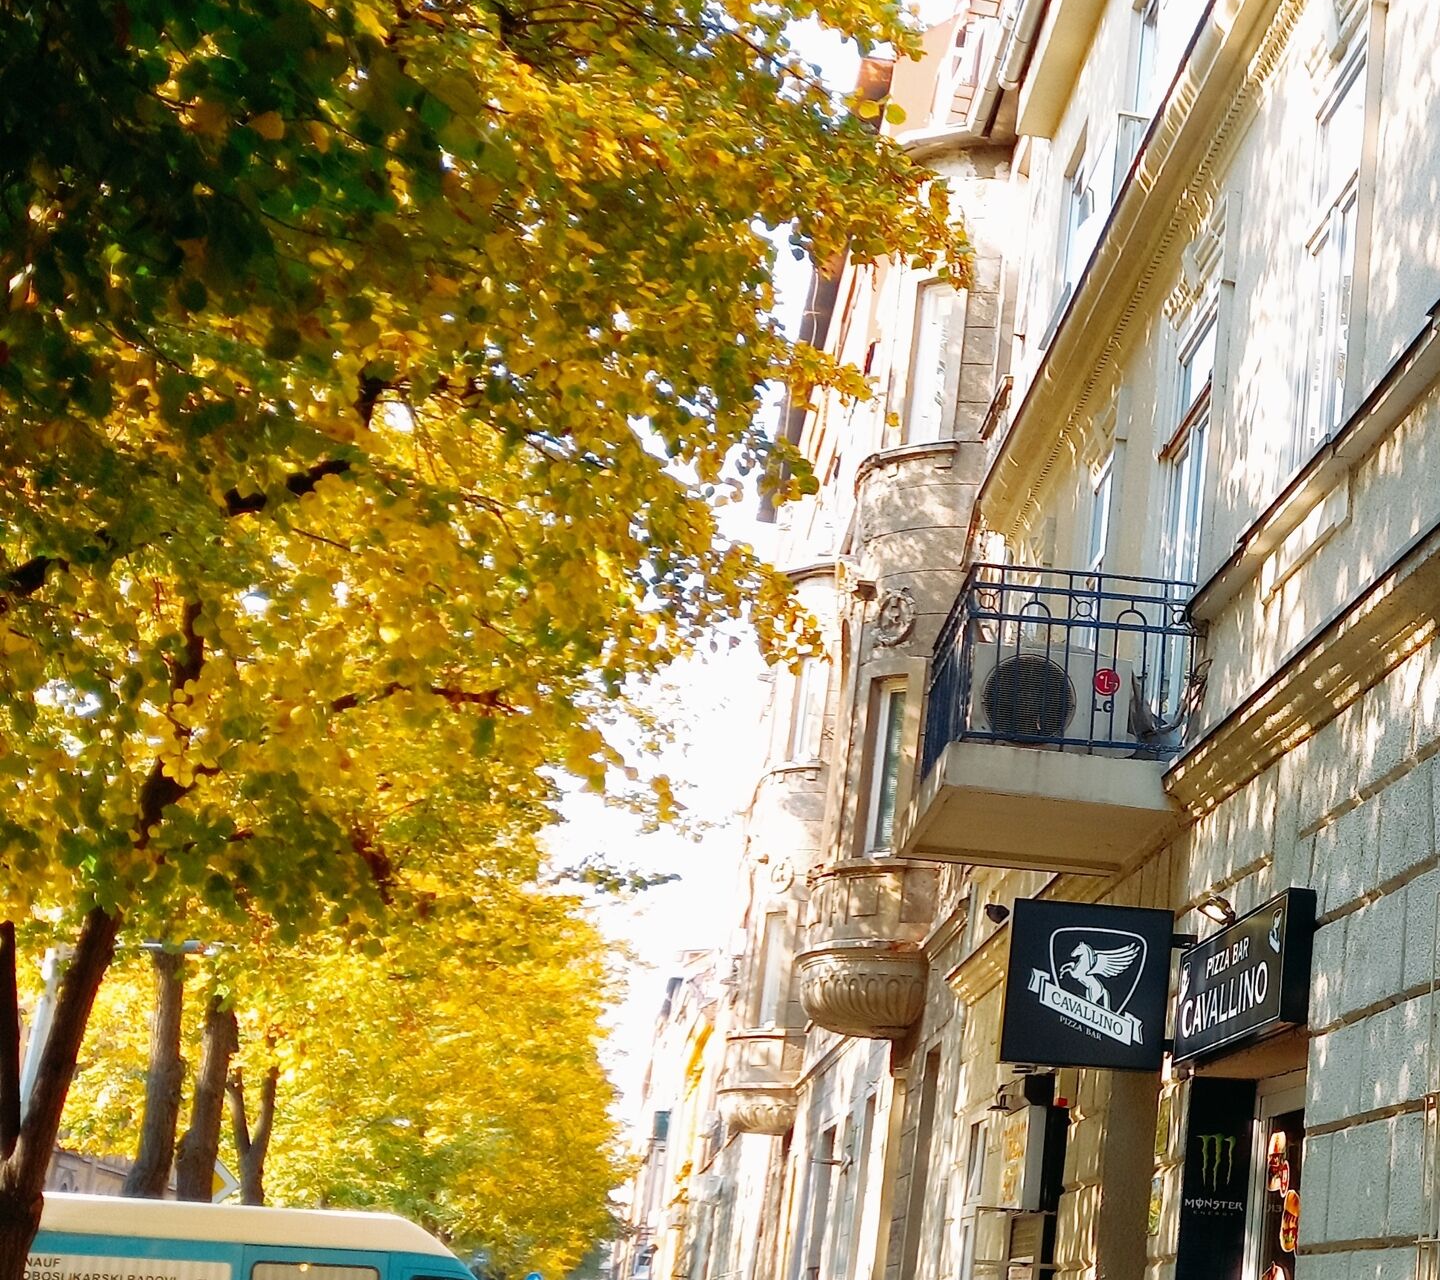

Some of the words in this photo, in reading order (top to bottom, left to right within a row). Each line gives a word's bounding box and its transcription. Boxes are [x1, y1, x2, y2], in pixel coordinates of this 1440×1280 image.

[1205, 947, 1230, 979] PIZZA
[1231, 936, 1249, 966] BAR
[1051, 991, 1123, 1036] CAVALLINO
[1181, 961, 1268, 1039] CAVALLINO
[1059, 1015, 1083, 1032] PIZZA
[1085, 1027, 1102, 1041] BAR
[24, 1257, 61, 1268] NAUF
